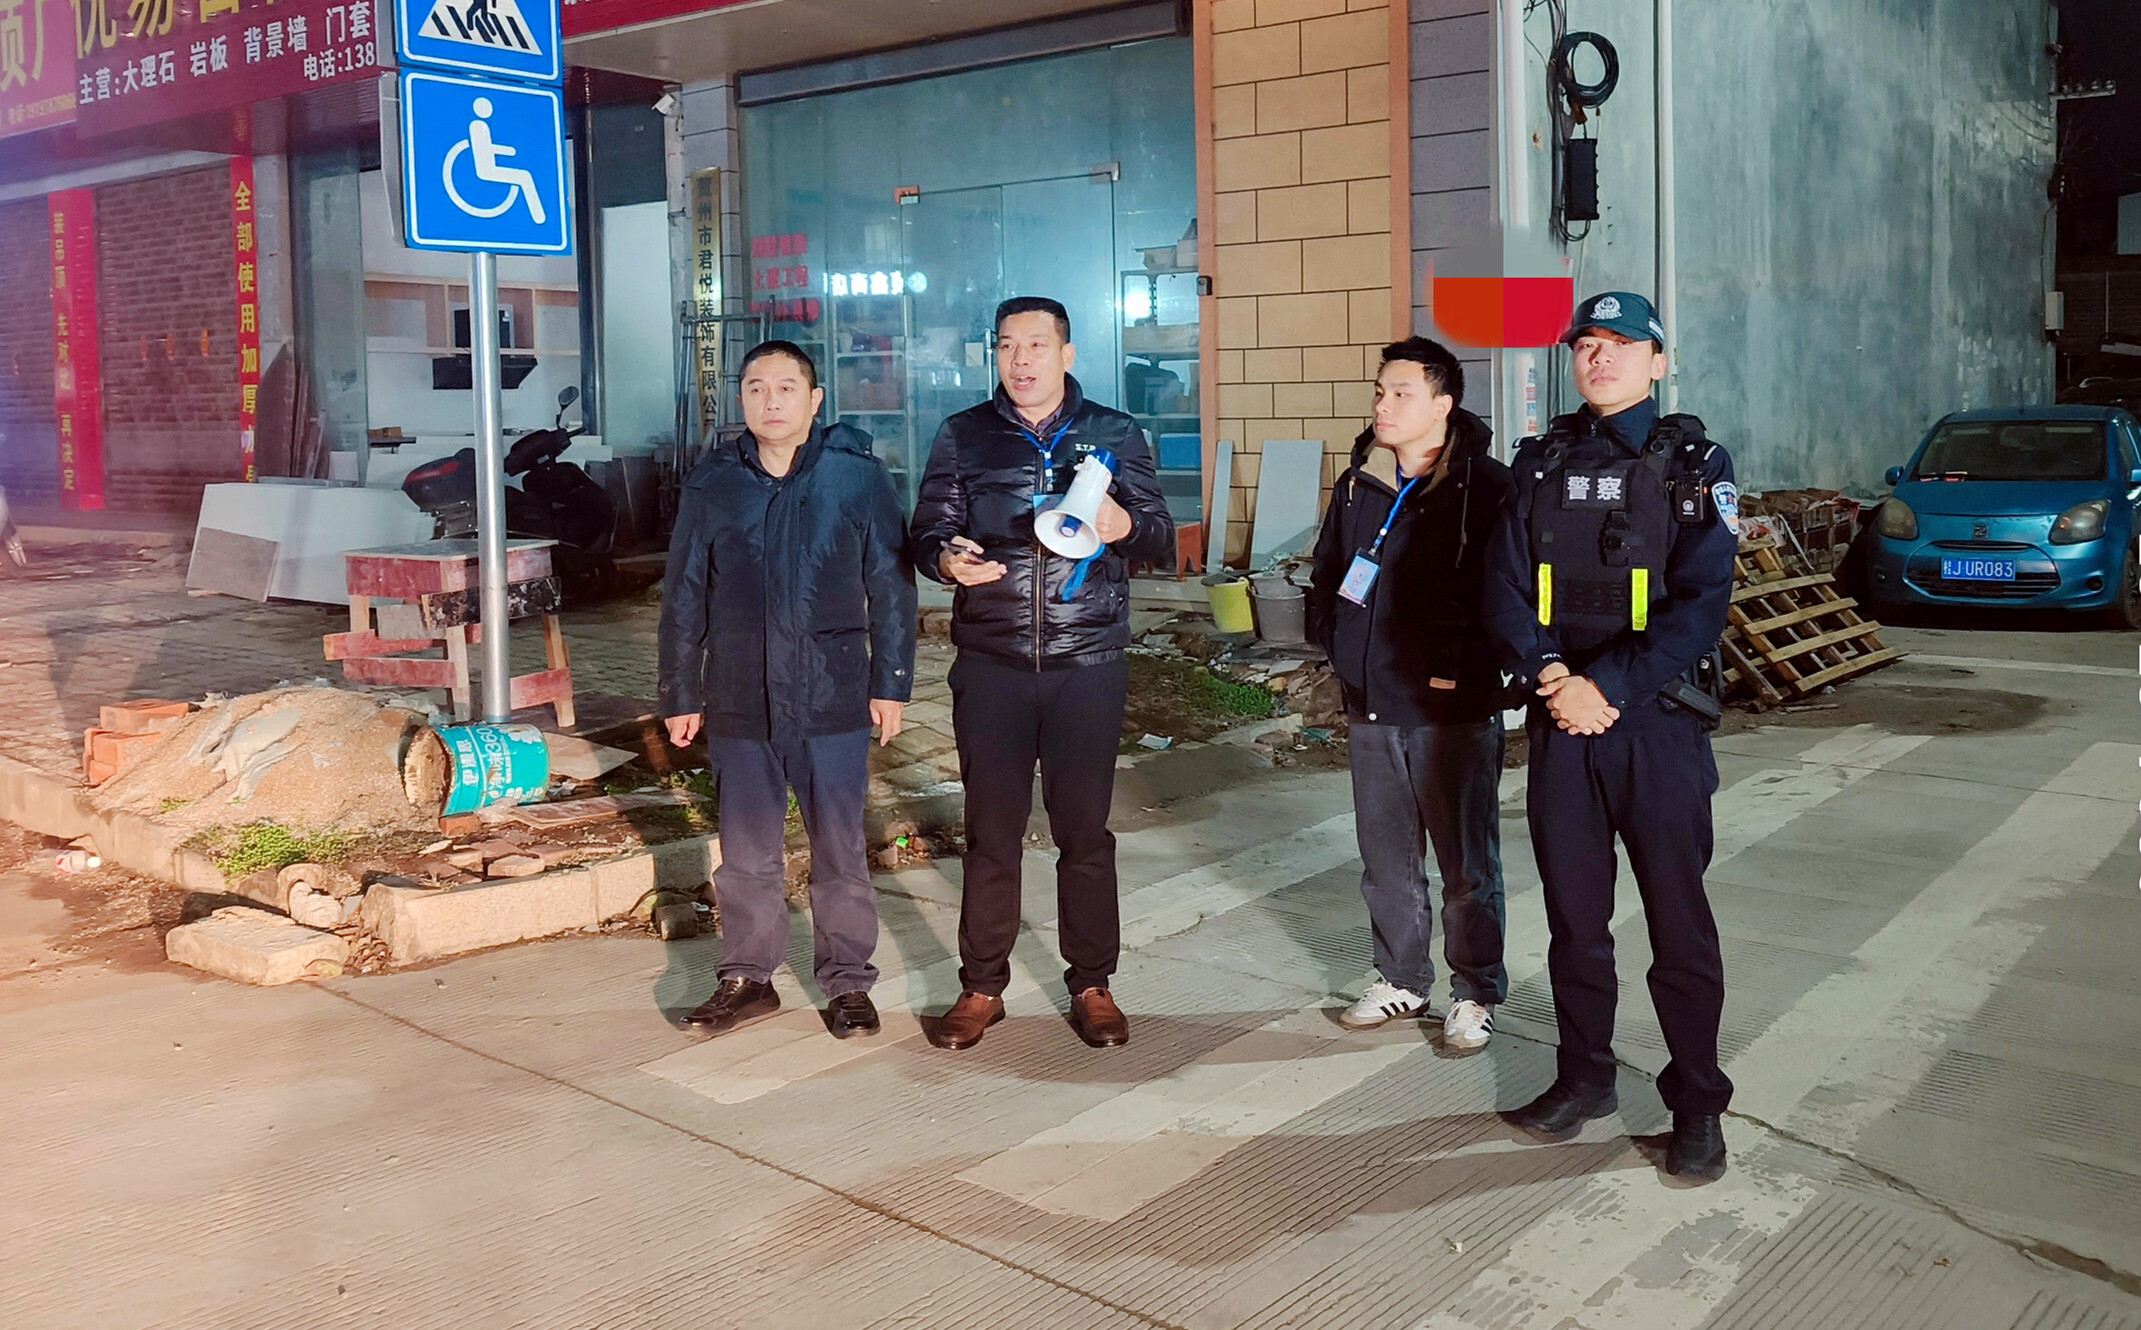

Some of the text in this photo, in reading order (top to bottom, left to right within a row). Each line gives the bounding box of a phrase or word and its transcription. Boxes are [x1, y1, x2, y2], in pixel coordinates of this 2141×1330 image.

[189, 35, 228, 77] 岩板
[243, 14, 308, 64] 背景墙
[325, 0, 371, 45] 门套
[1567, 475, 1622, 500] 警察
